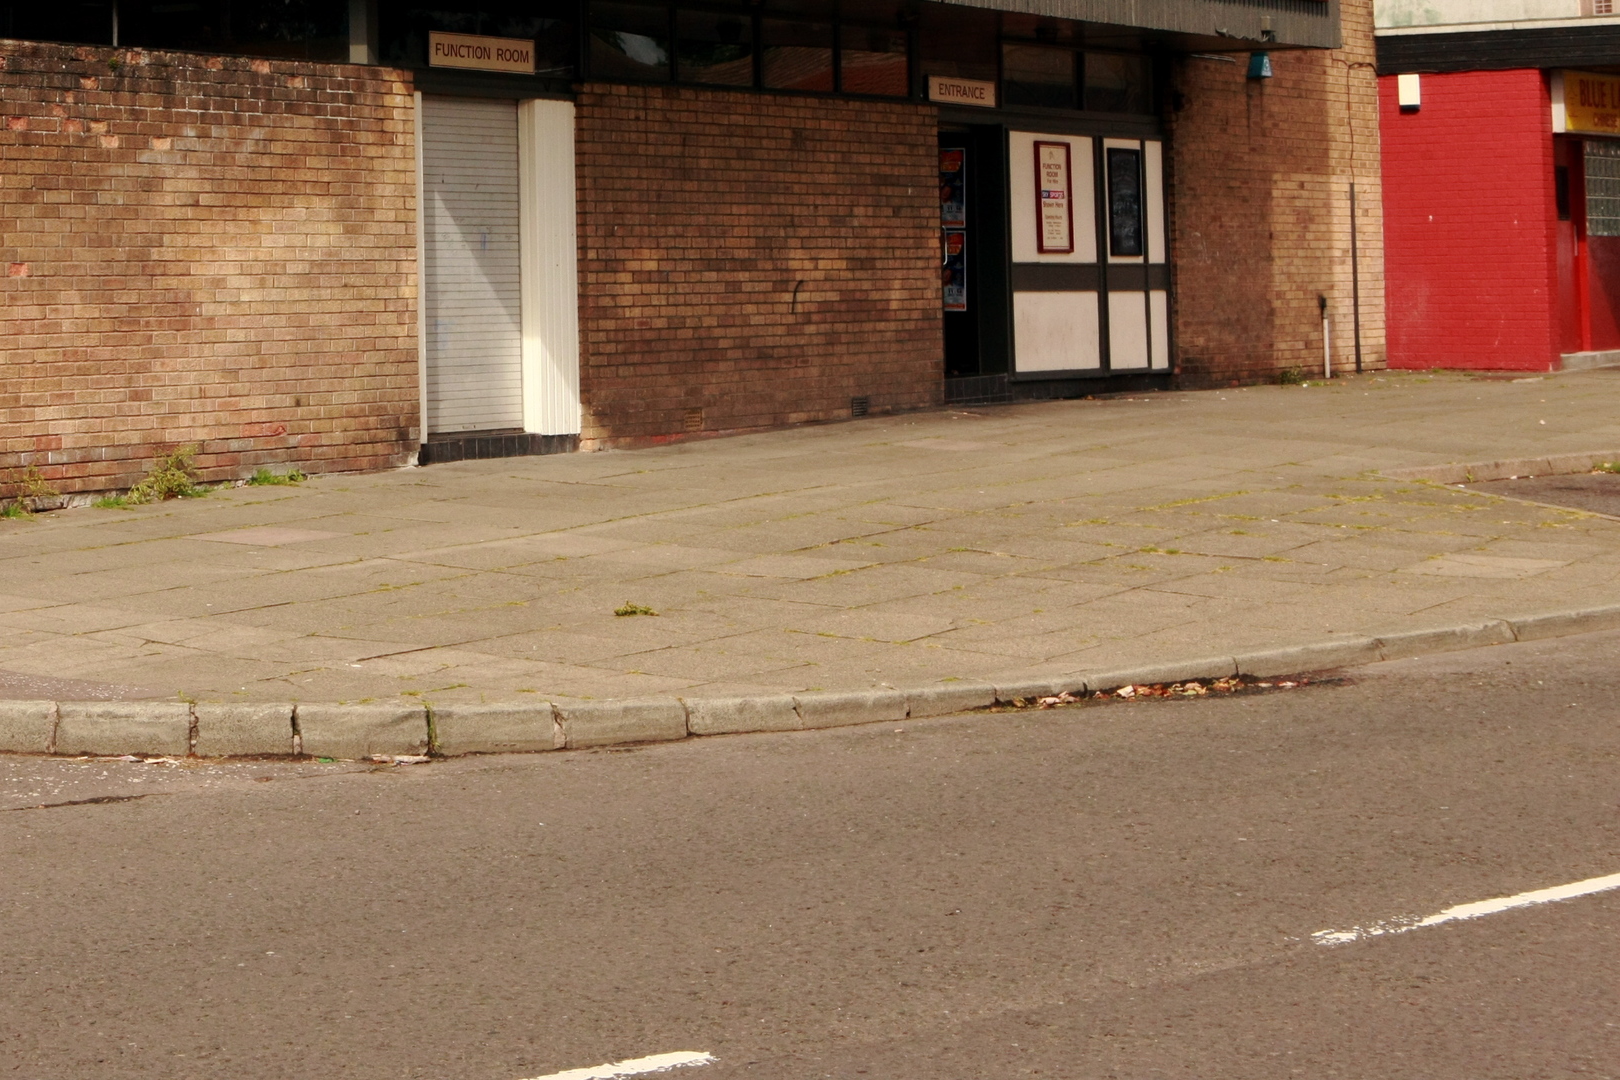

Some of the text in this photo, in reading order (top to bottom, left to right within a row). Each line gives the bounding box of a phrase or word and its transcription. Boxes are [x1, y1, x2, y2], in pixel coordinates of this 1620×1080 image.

[435, 42, 530, 64] FUNCTION ROOM
[938, 82, 986, 100] ENTRANCE
[1579, 79, 1607, 108] BLUE
